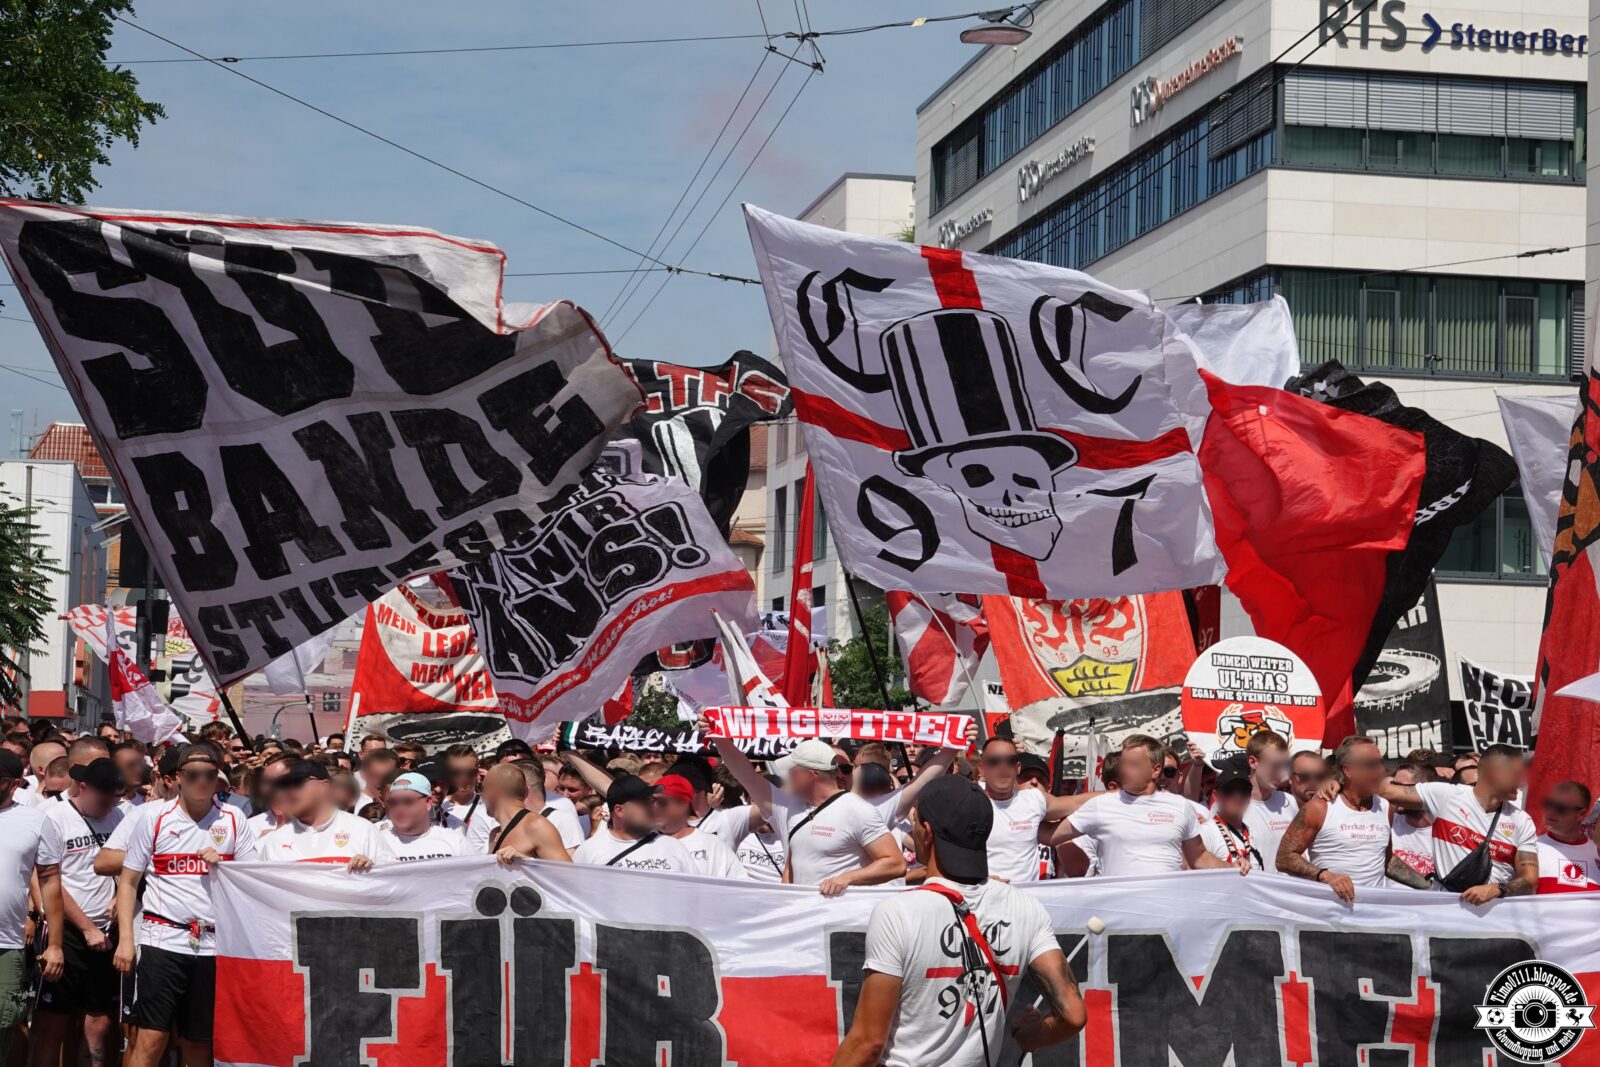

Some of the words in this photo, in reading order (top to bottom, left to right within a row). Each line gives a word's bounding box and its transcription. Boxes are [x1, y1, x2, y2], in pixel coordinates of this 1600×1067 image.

[1318, 0, 1408, 50] RTS
[1450, 22, 1588, 54] SteuerBer
[131, 359, 607, 592] BANDE
[377, 603, 417, 635] MEIN
[1102, 645, 1119, 658] 93
[1211, 653, 1250, 669] IMMER
[1249, 656, 1294, 673] WEITER
[410, 662, 455, 684] MEIN
[1218, 669, 1289, 694] ULTRAS
[1191, 687, 1217, 700] EGAL
[1216, 690, 1235, 701] WIE
[1235, 692, 1272, 705] STEINIG
[1273, 694, 1293, 706] DER
[1292, 695, 1318, 707] WEG!
[291, 880, 736, 1067] FÜR
